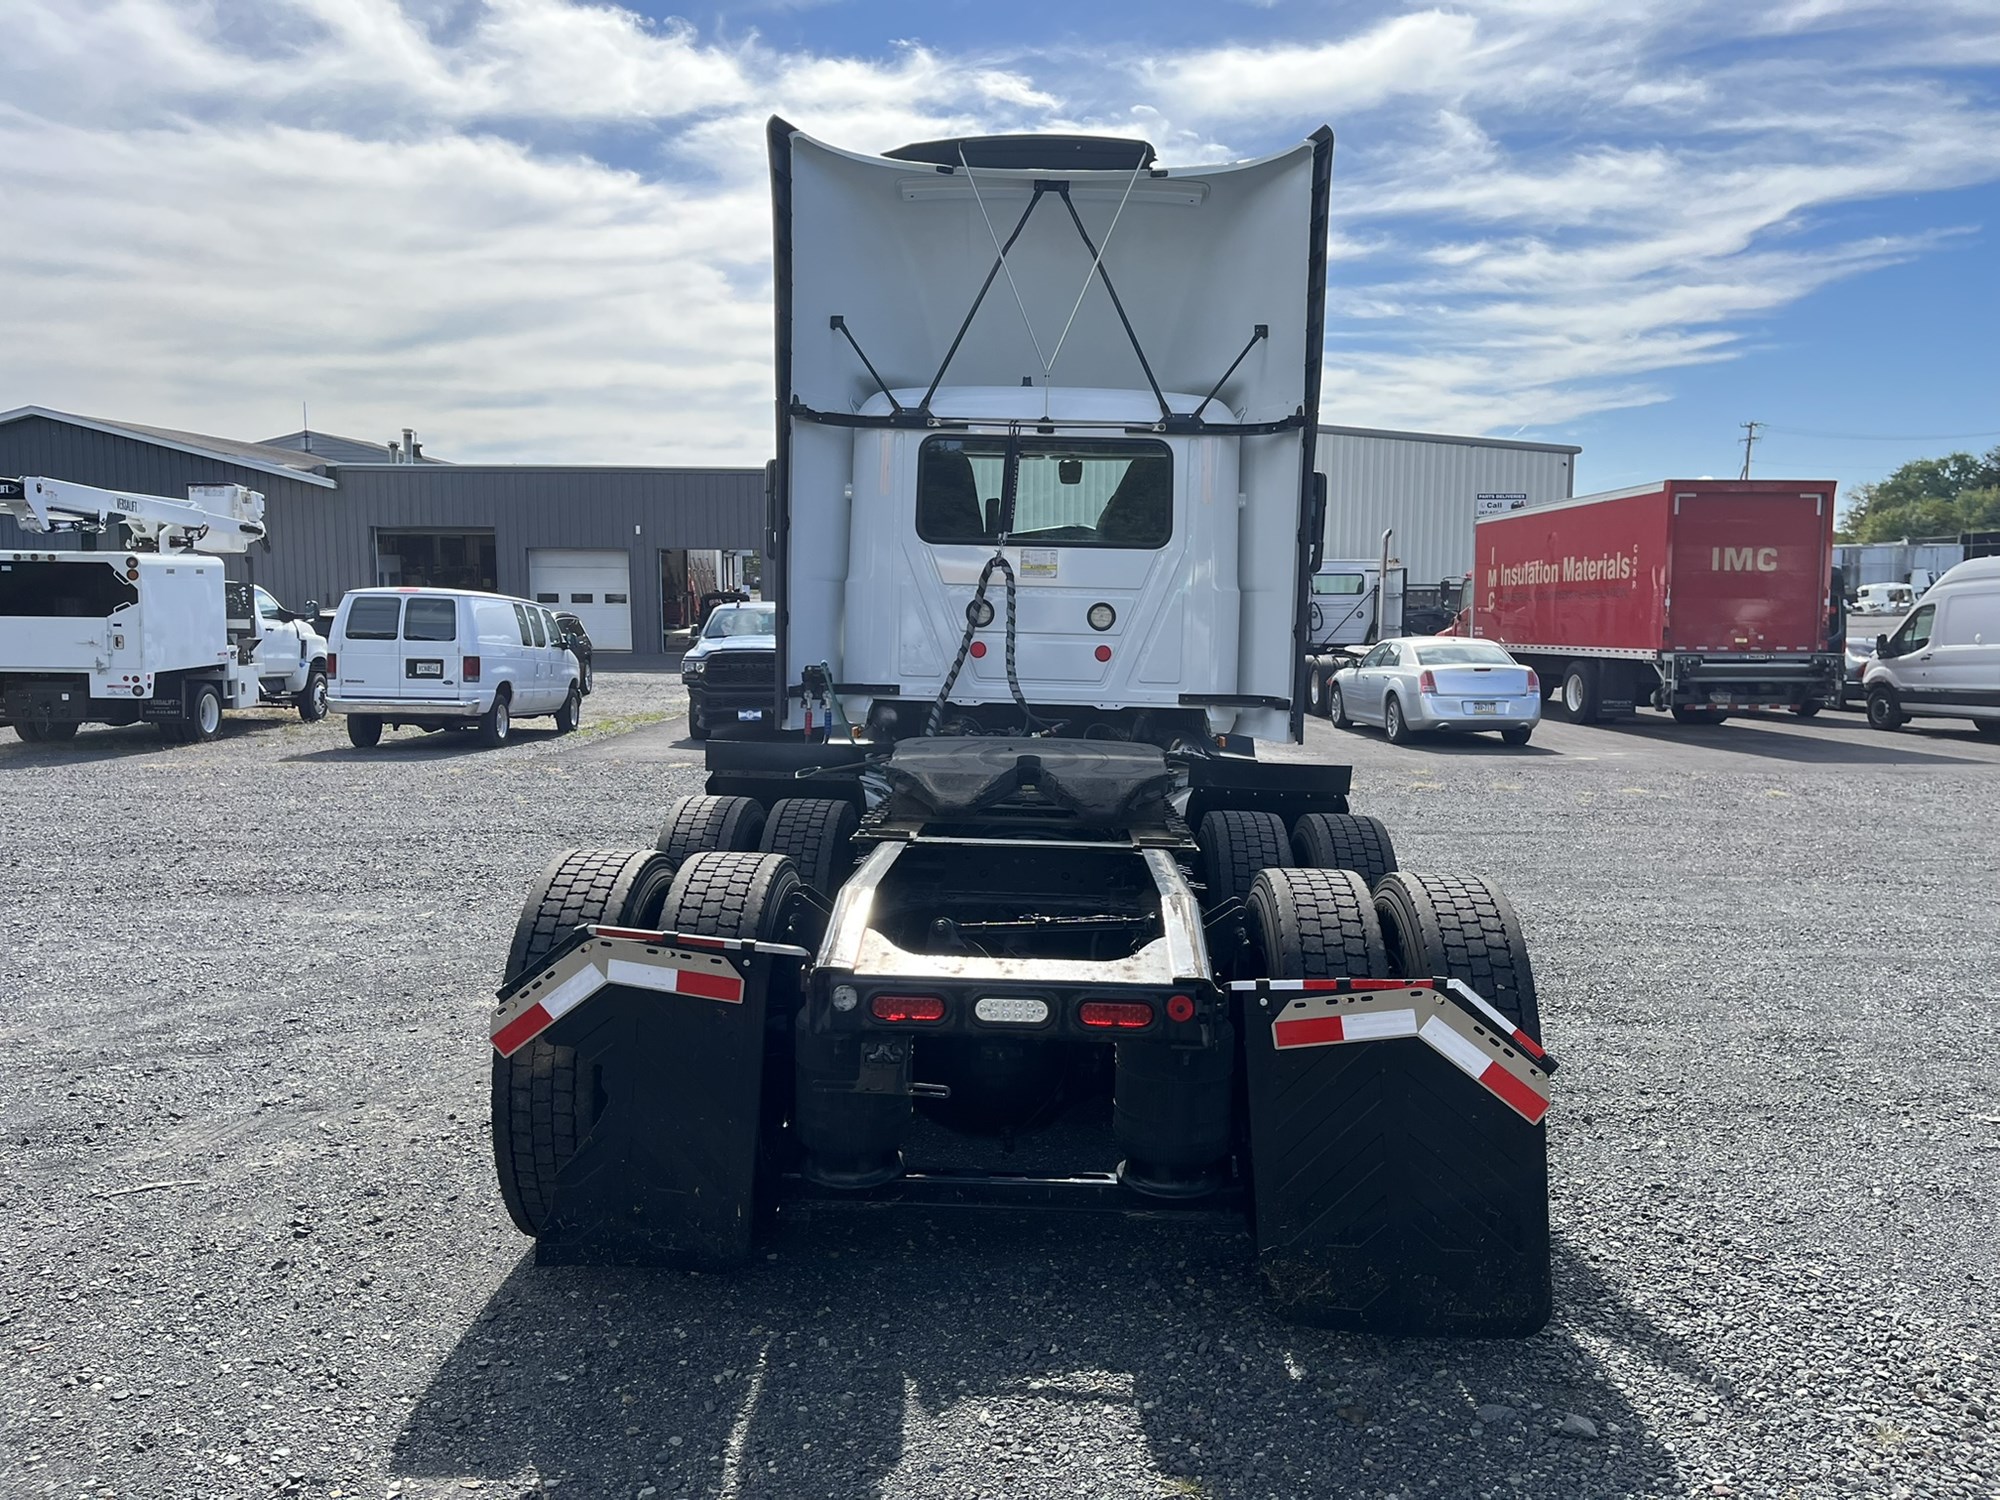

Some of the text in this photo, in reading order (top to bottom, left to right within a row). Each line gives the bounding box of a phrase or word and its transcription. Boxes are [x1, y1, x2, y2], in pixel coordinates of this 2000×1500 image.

[116, 497, 138, 513] VERSALIFT
[1500, 551, 1630, 586] Insulation Materials
[1711, 546, 1778, 572] IMC
